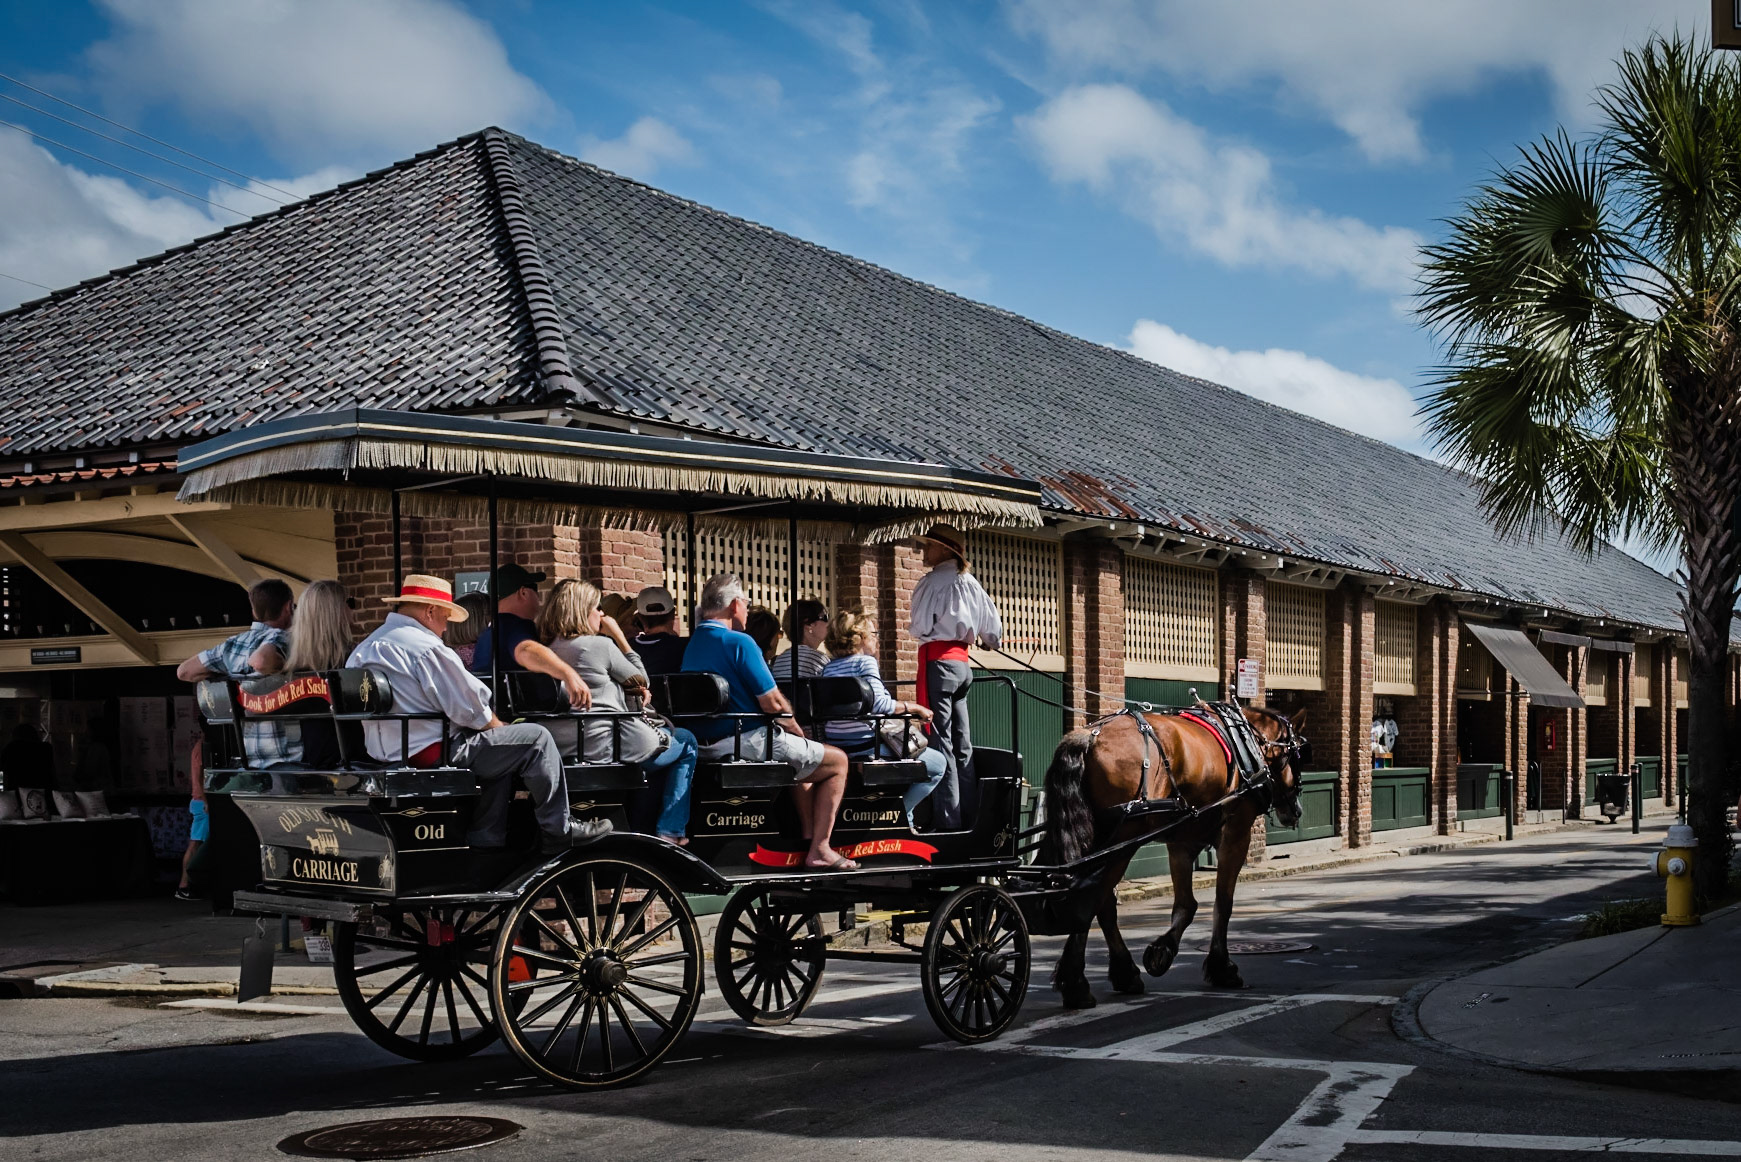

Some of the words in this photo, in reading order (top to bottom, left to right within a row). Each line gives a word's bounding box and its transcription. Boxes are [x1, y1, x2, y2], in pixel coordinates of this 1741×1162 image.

[243, 692, 263, 712] Look
[264, 695, 276, 713] for
[277, 689, 289, 707] the
[289, 679, 305, 700] Red
[306, 678, 327, 695] Sash
[278, 808, 303, 833] OLD
[706, 811, 765, 829] Carriage
[842, 808, 901, 825] Company
[414, 824, 445, 840] Old
[837, 847, 851, 859] he
[853, 841, 875, 857] Red
[876, 839, 902, 853] Sash
[292, 857, 359, 883] CARRIAGE
